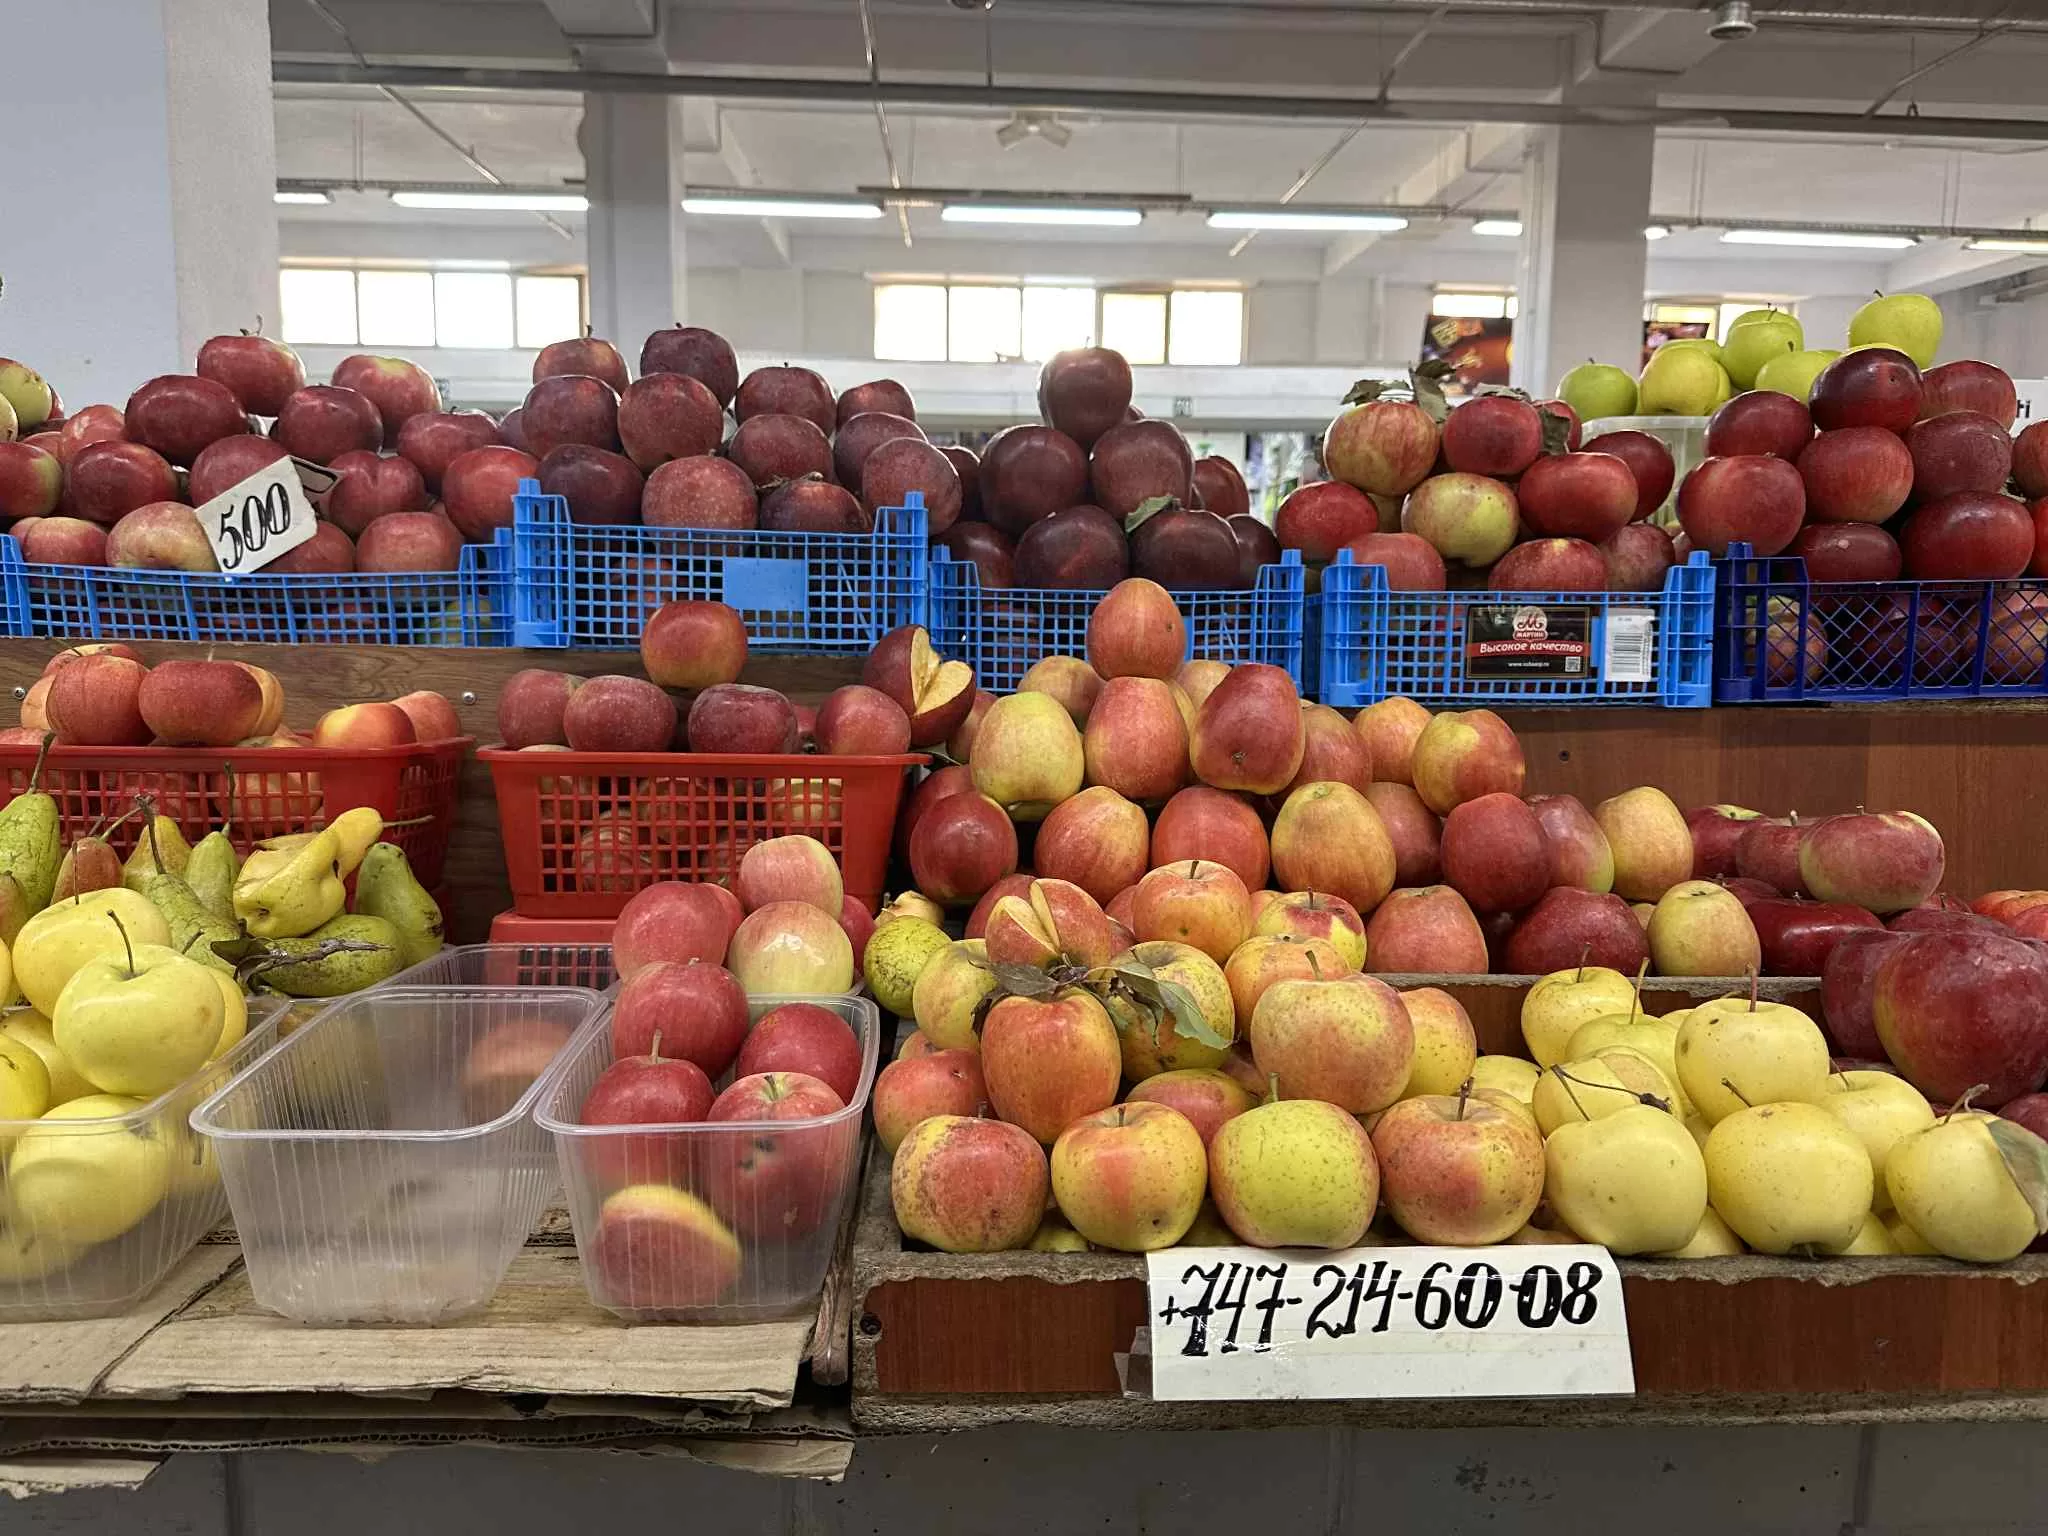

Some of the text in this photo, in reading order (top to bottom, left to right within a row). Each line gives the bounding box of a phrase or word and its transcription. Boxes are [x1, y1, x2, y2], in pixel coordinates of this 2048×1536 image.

[218, 482, 291, 570] 500
[1479, 642, 1583, 653] Высокое качество
[1159, 1260, 1604, 1357] +747-214-60-08
